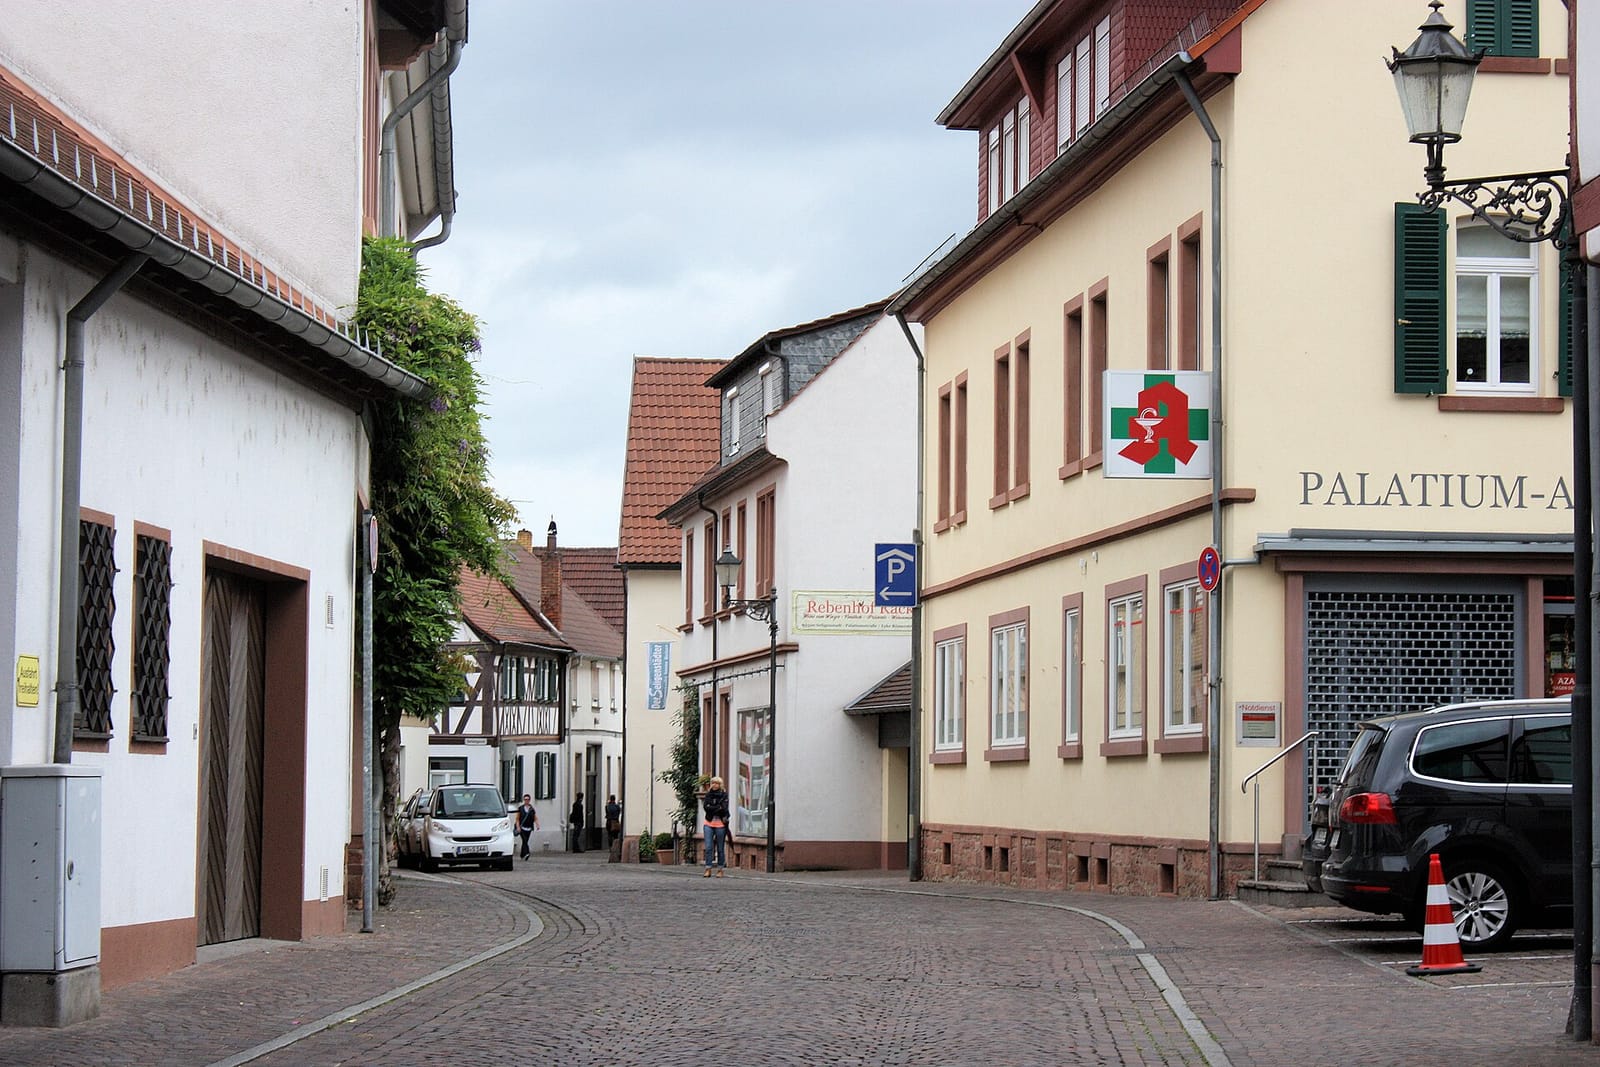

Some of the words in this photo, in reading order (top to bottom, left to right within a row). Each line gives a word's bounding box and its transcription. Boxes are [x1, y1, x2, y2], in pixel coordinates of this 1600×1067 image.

[1299, 471, 1574, 510] PALATIUM-A
[887, 558, 906, 583] P
[807, 599, 875, 614] Rebenhof
[1241, 703, 1276, 711] Notdienst
